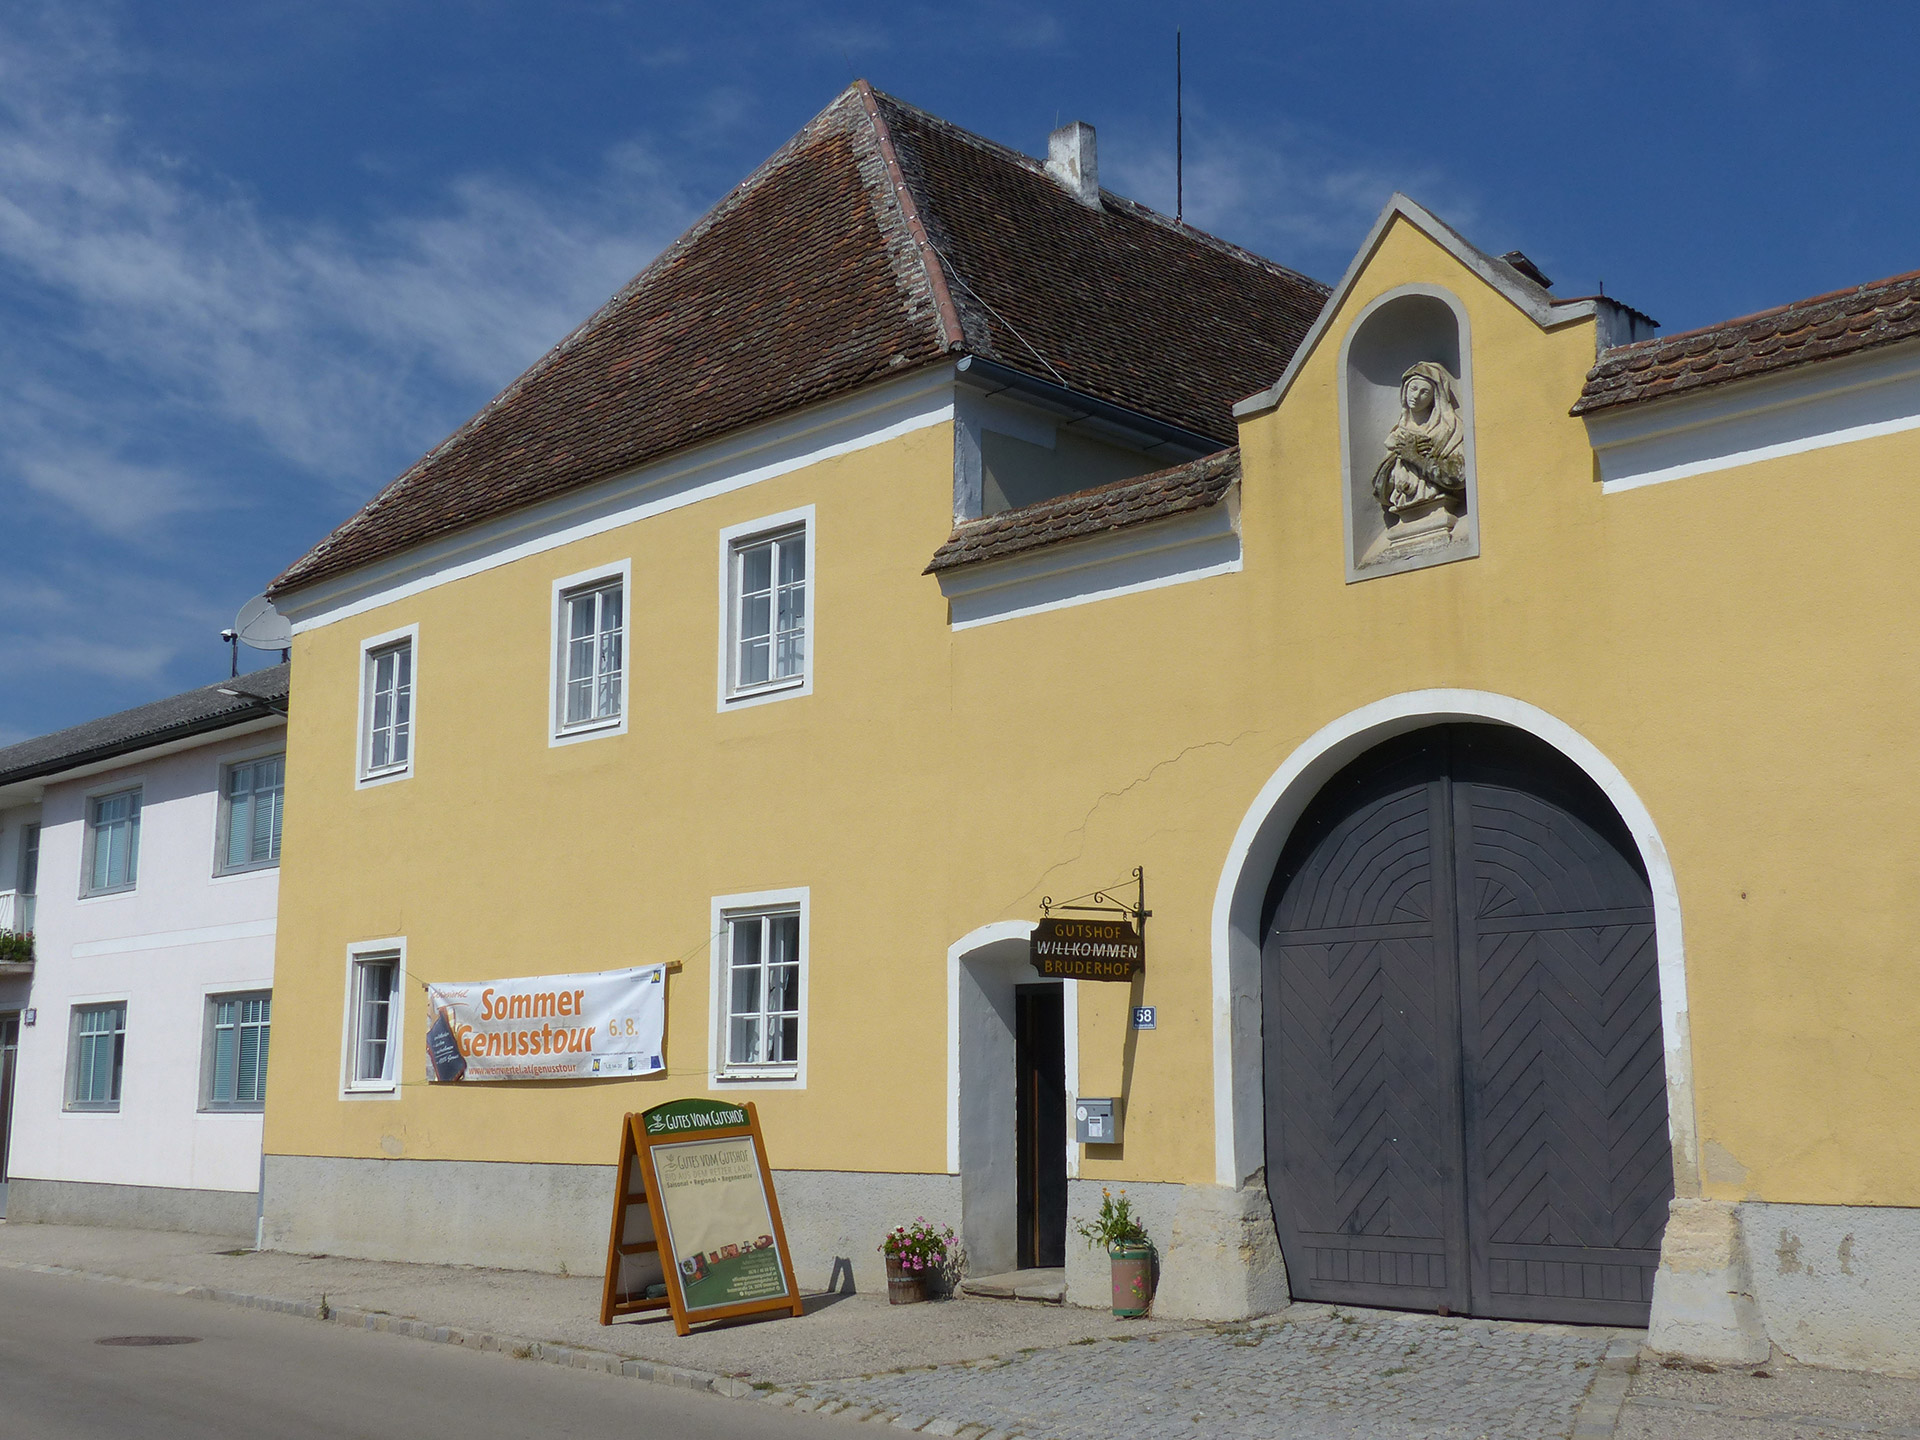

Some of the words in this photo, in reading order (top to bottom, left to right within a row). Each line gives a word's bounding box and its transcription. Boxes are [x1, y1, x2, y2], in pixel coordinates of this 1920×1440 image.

[1055, 924, 1121, 939] GUTSHOF
[1037, 940, 1138, 959] WILLKOMMEN
[1044, 960, 1130, 975] BRUDERHOF
[481, 988, 585, 1022] Sommer
[1136, 1009, 1152, 1022] 58
[609, 1018, 622, 1036] 6.
[626, 1017, 639, 1036] 8.
[457, 1022, 597, 1057] Genusstour
[468, 1064, 577, 1076] www.weinviertel.at/genusstour
[665, 1113, 691, 1130] GUTES
[691, 1112, 711, 1128] VOM
[711, 1109, 745, 1126] GUTSHOF
[677, 1154, 699, 1170] GUTES
[700, 1152, 719, 1167] VOM
[718, 1149, 749, 1165] GUTSHOF
[666, 1180, 689, 1189] Saisonal
[694, 1177, 717, 1186] Regional
[721, 1173, 753, 1182] Regenerativ
